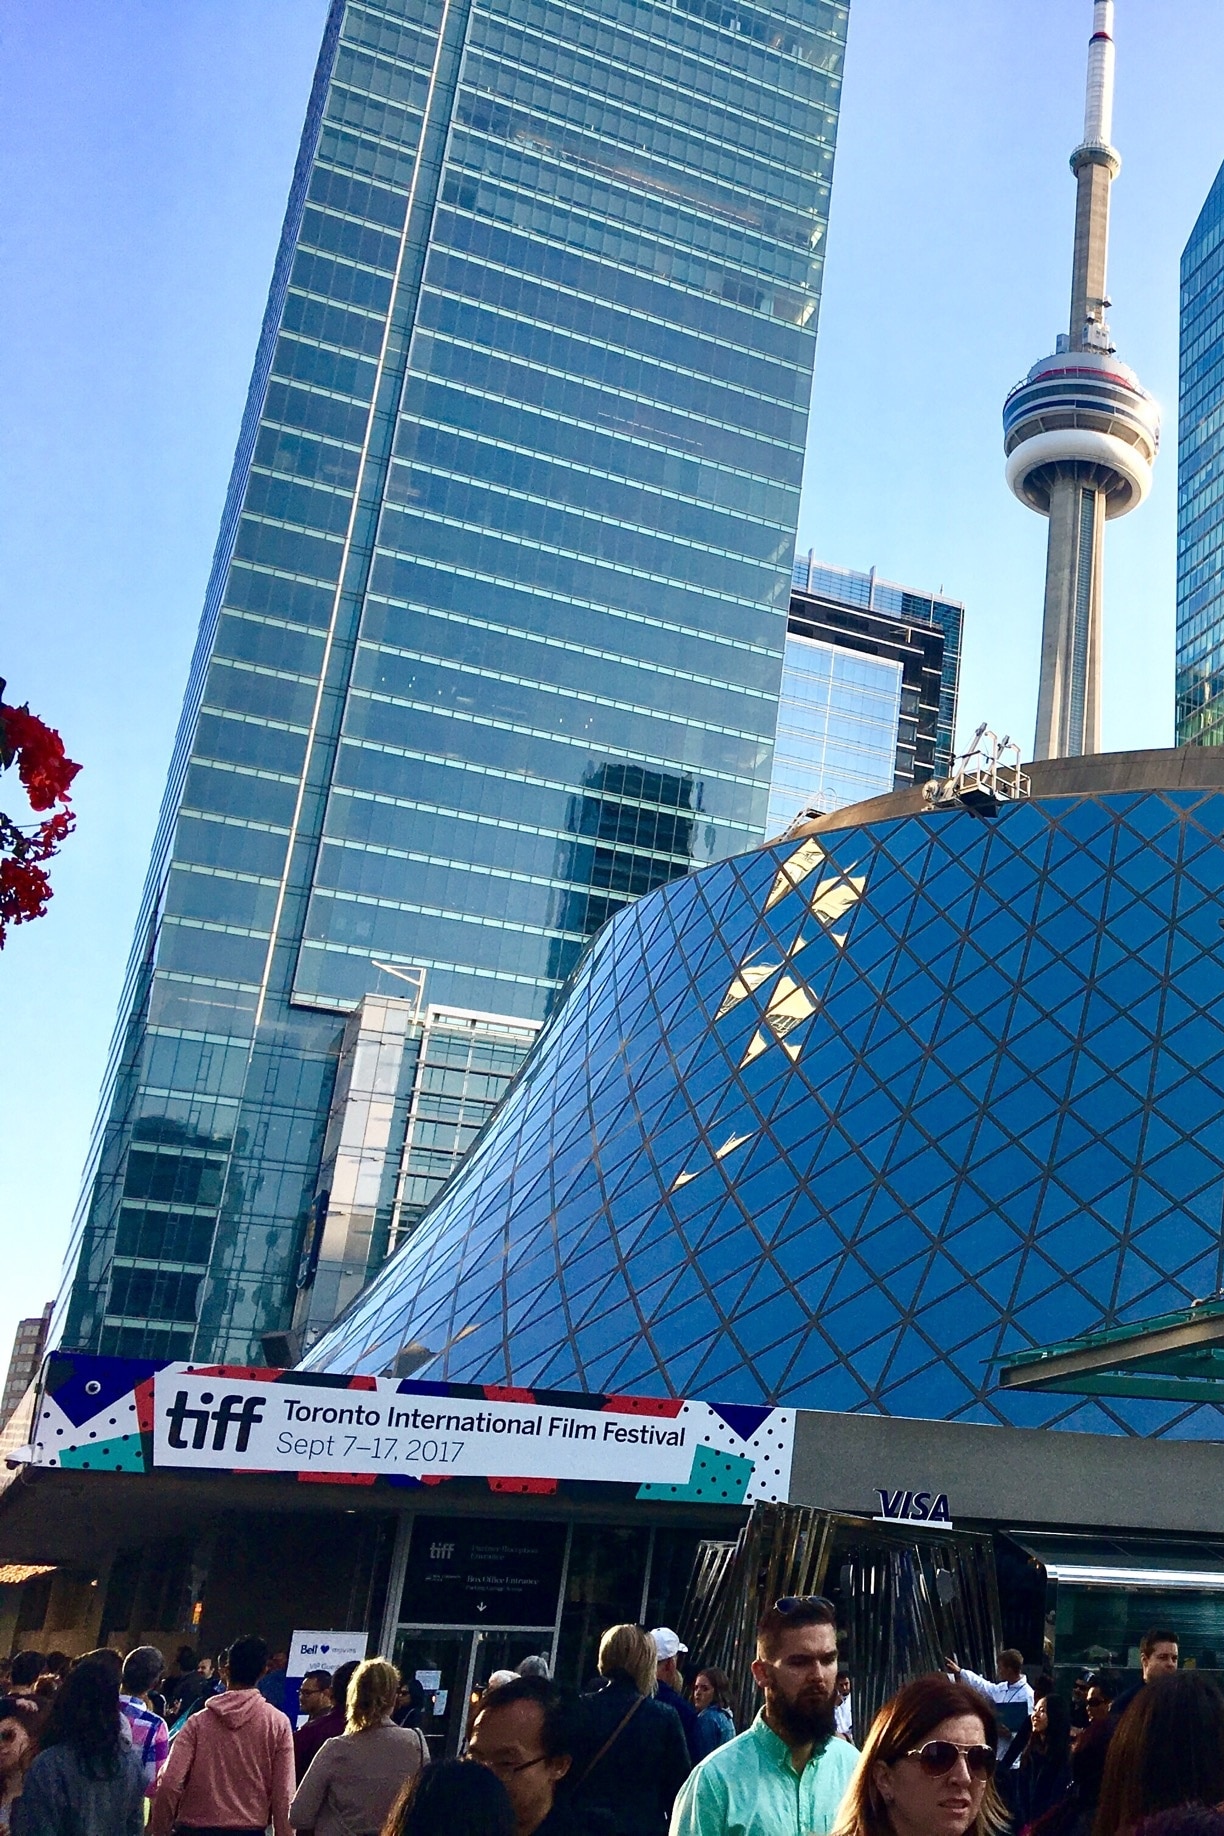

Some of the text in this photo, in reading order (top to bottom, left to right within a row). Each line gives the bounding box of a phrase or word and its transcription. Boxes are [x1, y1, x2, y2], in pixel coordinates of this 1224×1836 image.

[166, 1390, 267, 1453] tiff
[284, 1399, 686, 1447] Toronto International Film Festival
[276, 1431, 336, 1460] Sept
[405, 1439, 465, 1463] 2017
[872, 1488, 952, 1523] VISA
[429, 1542, 455, 1560] tiff
[467, 1575, 482, 1583] Box
[300, 1644, 318, 1655] Bell
